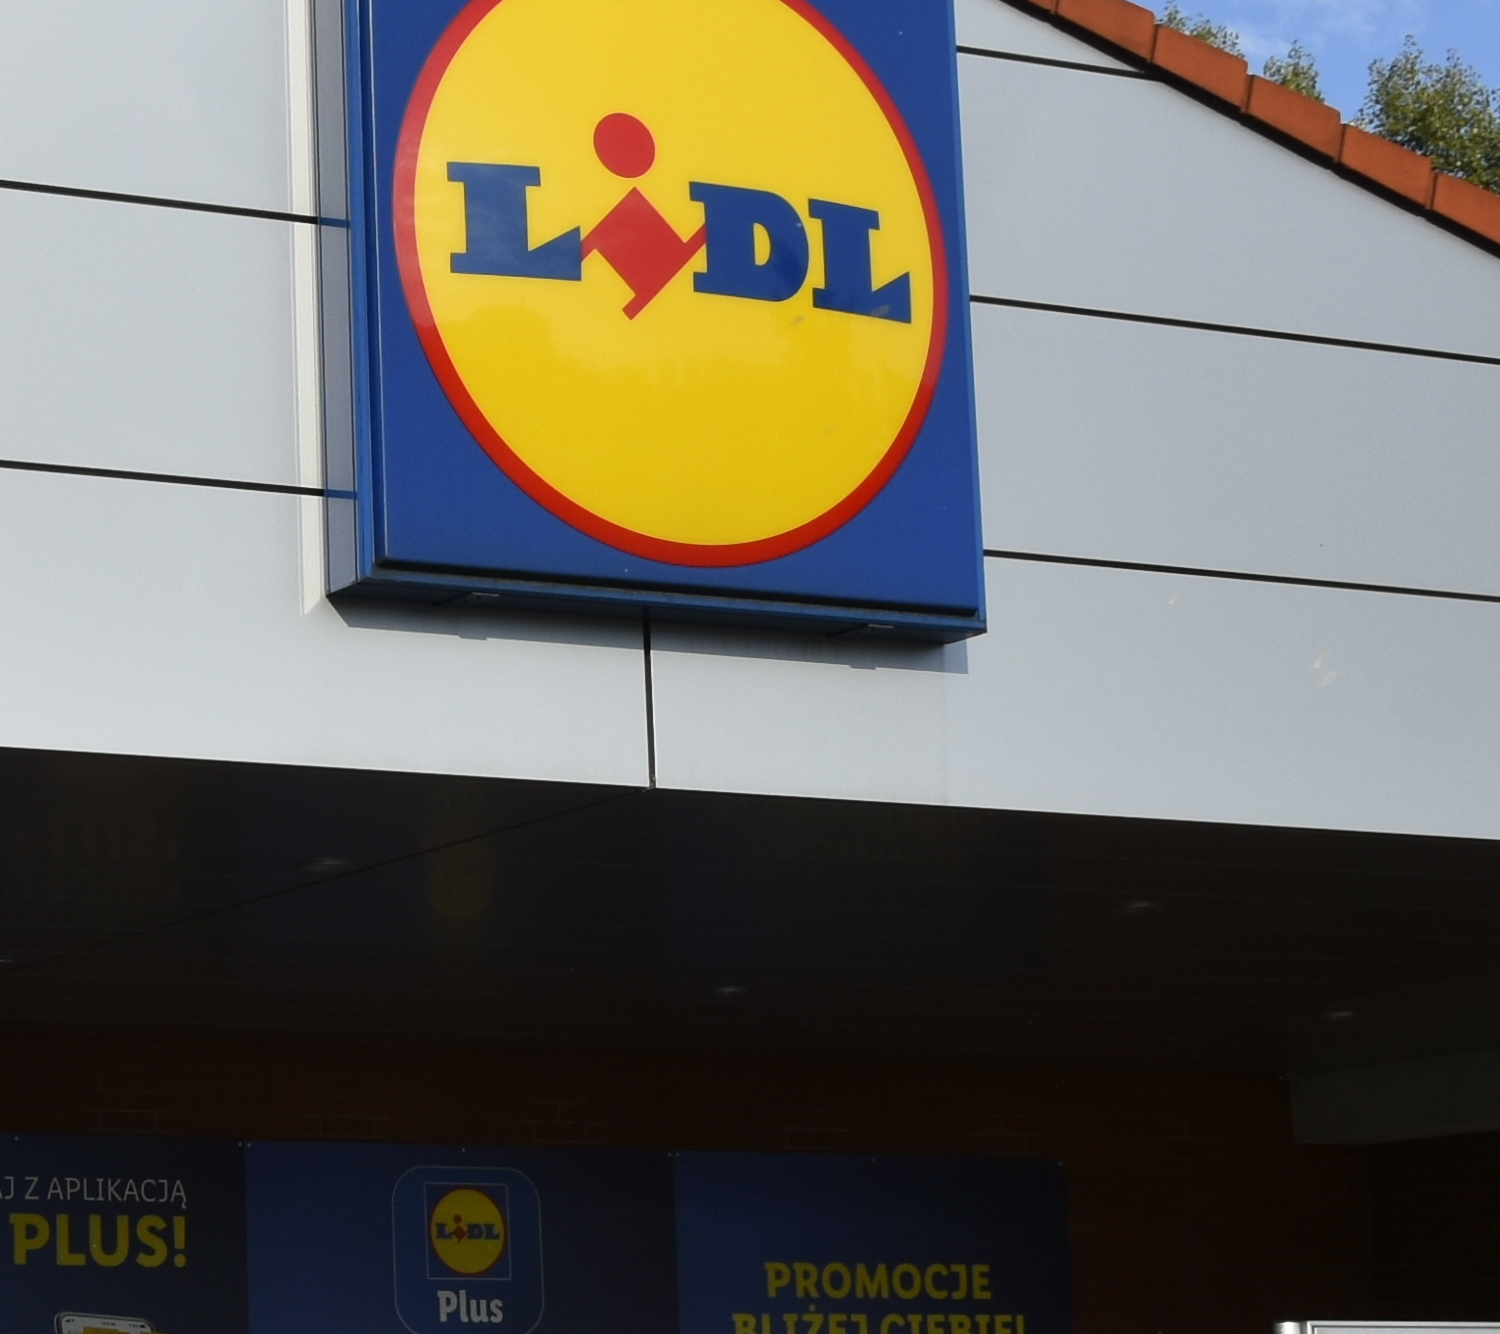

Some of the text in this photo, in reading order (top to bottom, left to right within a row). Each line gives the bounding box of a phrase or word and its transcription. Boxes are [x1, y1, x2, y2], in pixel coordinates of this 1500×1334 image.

[446, 112, 912, 325] LIDL
[24, 1177, 39, 1200] Z
[46, 1178, 187, 1209] APLIKACJĄ
[8, 1212, 187, 1268] PLUS!
[435, 1214, 500, 1243] LIDL
[764, 1261, 991, 1299] PROMOCJE
[437, 1289, 504, 1323] Plus
